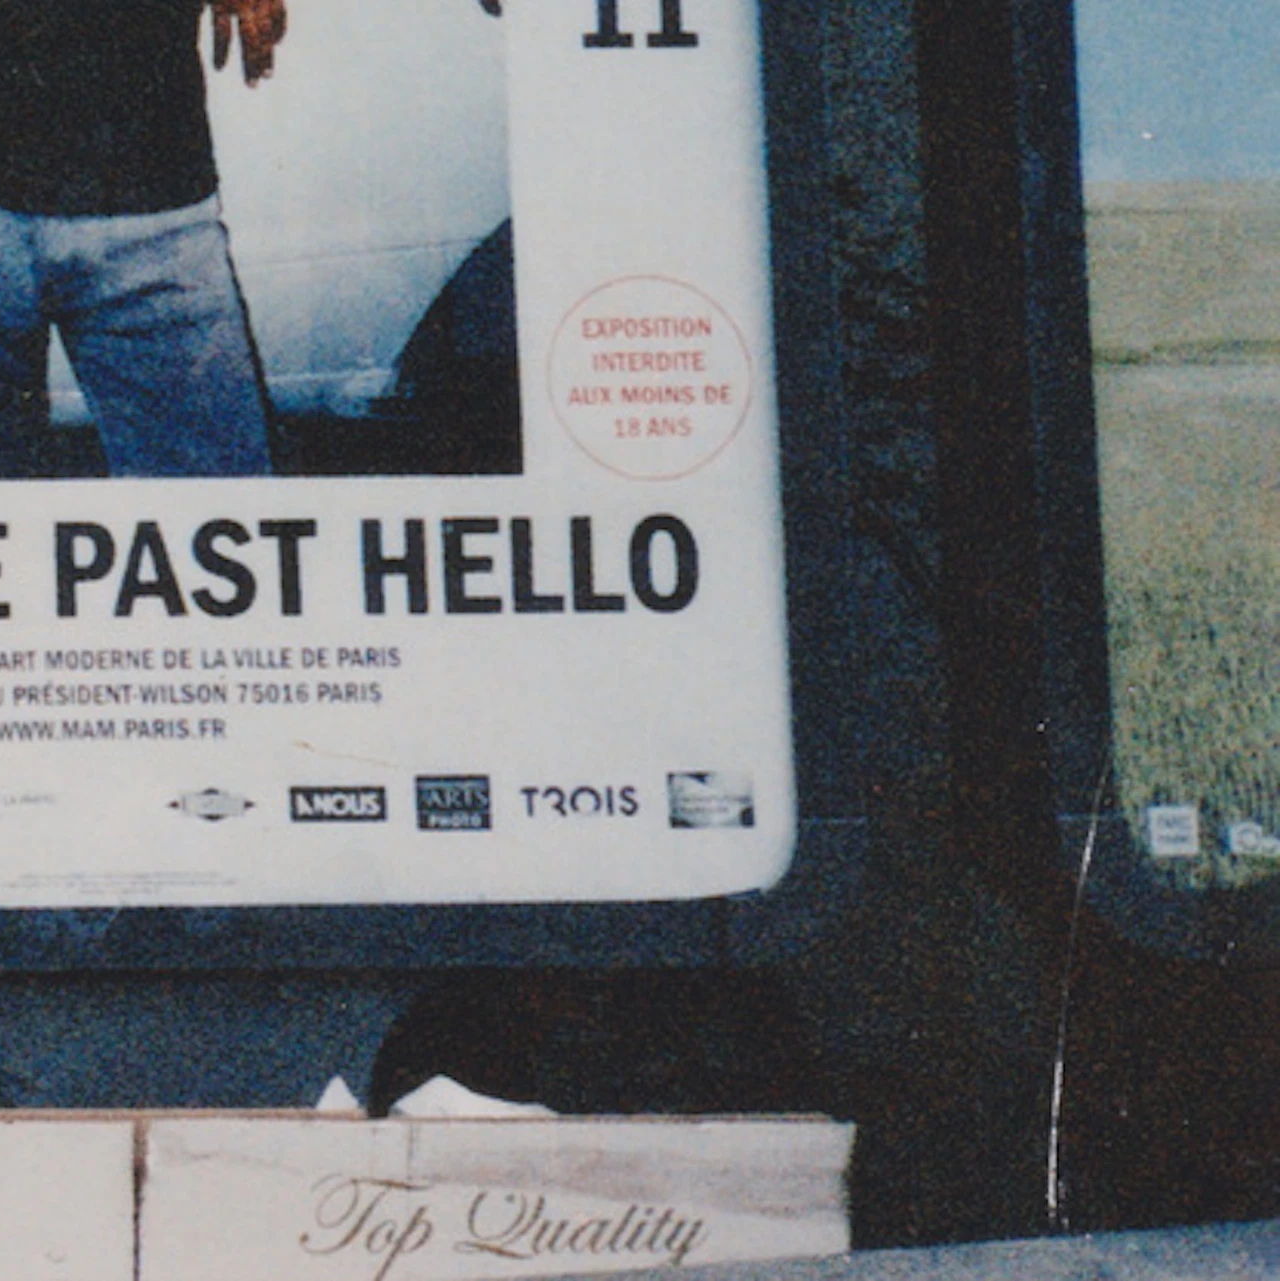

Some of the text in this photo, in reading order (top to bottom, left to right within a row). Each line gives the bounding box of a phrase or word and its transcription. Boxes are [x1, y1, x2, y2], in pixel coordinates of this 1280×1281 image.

[581, 317, 713, 340] EXPOSITION
[593, 350, 706, 373] INTERDITE
[567, 383, 733, 406] AUX MOINS DE
[615, 416, 694, 438] 18 ANS
[53, 519, 318, 620] PAST
[360, 513, 700, 616] HELLO
[44, 648, 157, 671] MODERNE
[163, 648, 193, 670] DE
[201, 648, 228, 669] LA
[232, 647, 294, 669] VILLE
[301, 647, 330, 669] DE
[337, 646, 402, 668] PARIS
[236, 682, 311, 704] 75016
[317, 681, 383, 703] PARIS
[298, 1173, 710, 1281] Top Quality
